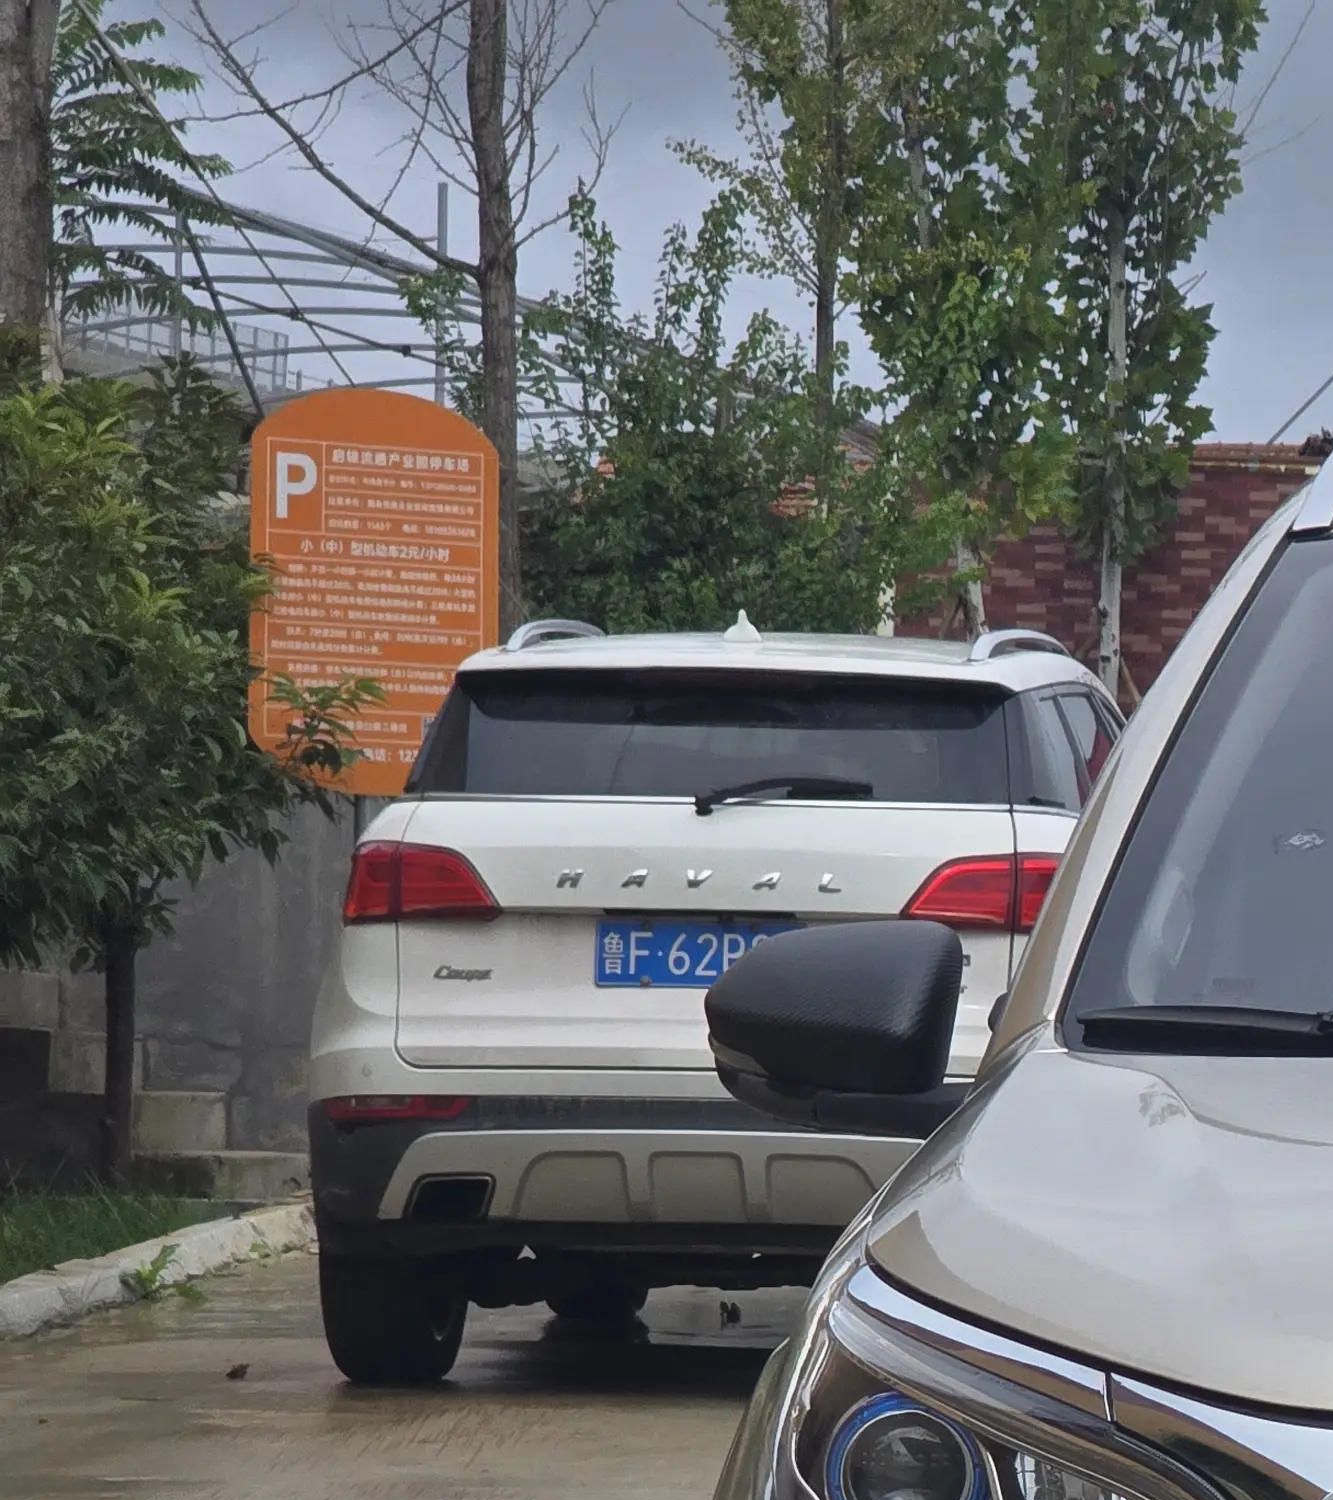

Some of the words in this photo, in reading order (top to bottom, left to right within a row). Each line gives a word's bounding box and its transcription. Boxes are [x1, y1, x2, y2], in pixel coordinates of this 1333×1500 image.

[276, 452, 317, 518] P
[556, 869, 842, 893] HAVAL
[602, 931, 768, 976] 鲁F·62P
